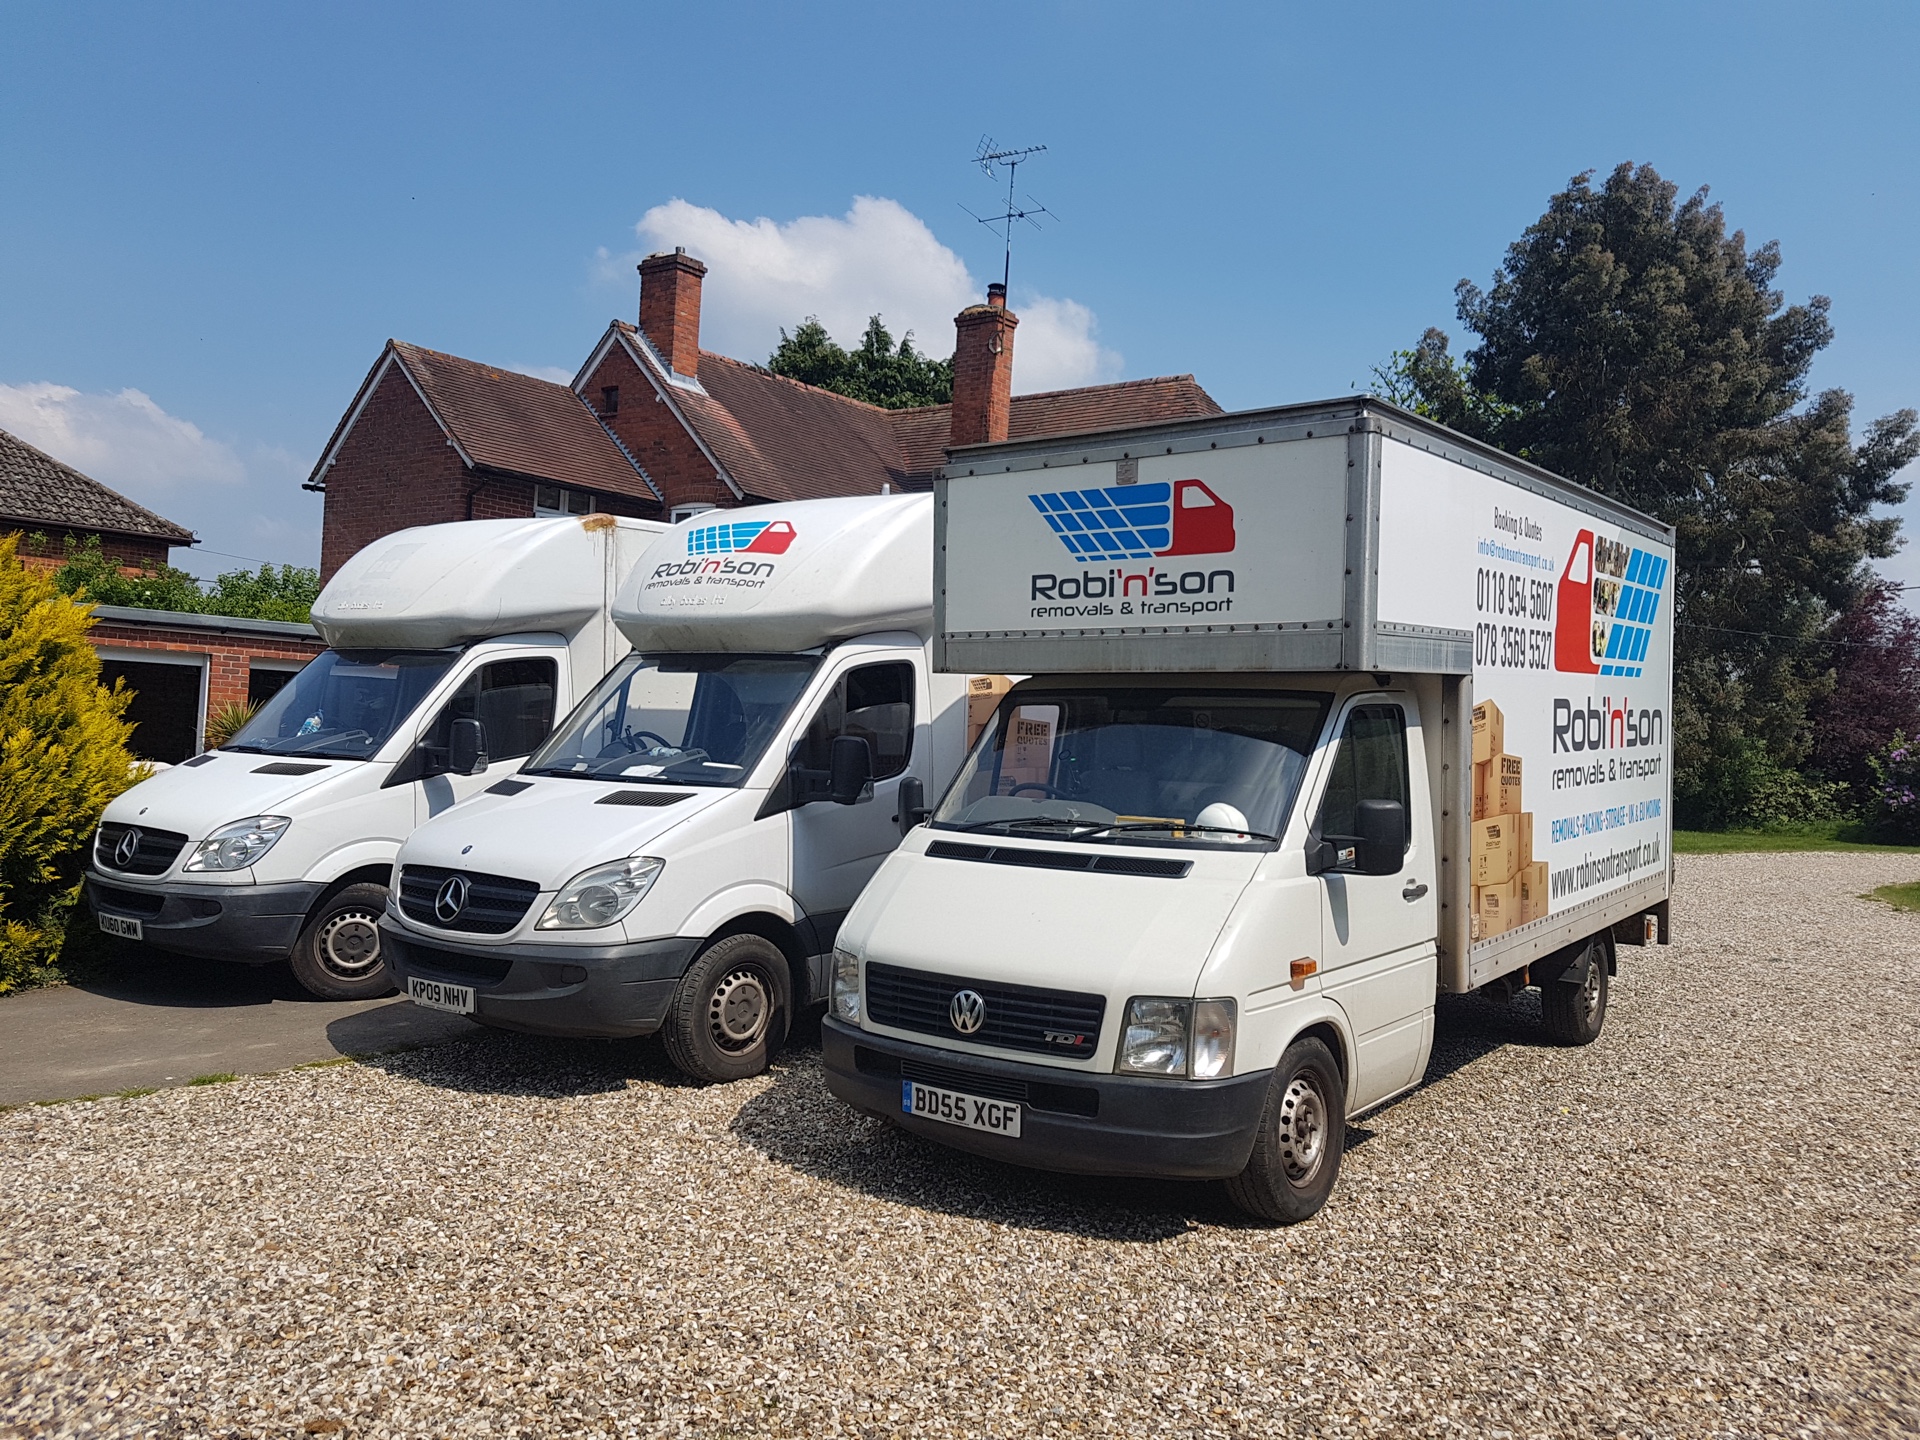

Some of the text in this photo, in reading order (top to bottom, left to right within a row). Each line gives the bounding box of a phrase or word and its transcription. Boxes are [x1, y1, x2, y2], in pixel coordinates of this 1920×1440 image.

[1494, 506, 1542, 542] Booking & Quotes
[644, 576, 766, 590] removals & transport
[1477, 567, 1554, 622] 0118 954 5607
[1030, 598, 1233, 618] removals & transport
[1476, 622, 1552, 670] 078 3569 5527
[1016, 736, 1048, 746] QUOTES
[1017, 720, 1048, 736] FREE
[1501, 757, 1520, 775] FREE
[1552, 752, 1662, 790] removals & transport
[1501, 776, 1520, 786] QUOTES
[1552, 832, 1660, 900] www.robinsontransport.co.uk
[412, 980, 440, 1002] KP09
[444, 986, 468, 1008] NHV
[915, 1086, 1016, 1130] BD55 XGF
